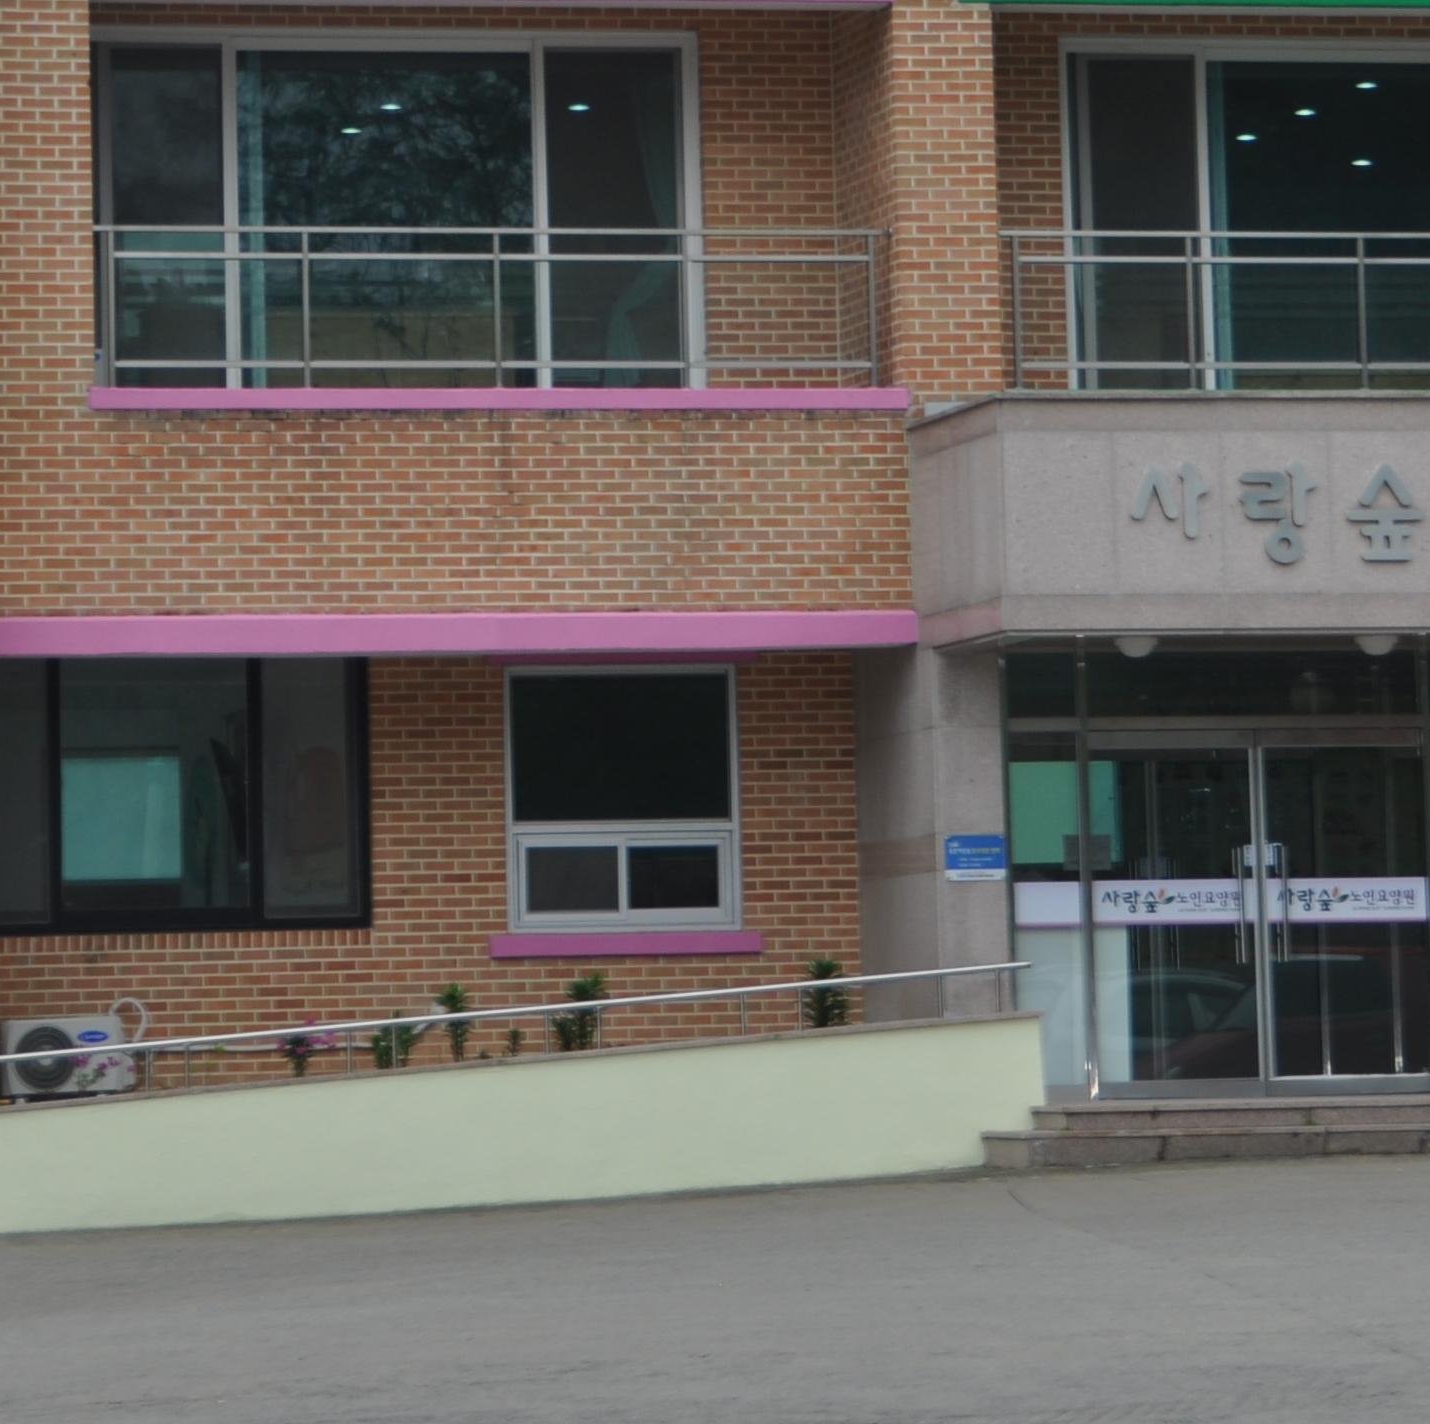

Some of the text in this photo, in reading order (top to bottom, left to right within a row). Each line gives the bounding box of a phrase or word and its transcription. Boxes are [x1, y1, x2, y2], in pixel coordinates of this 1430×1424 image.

[1101, 888, 1242, 914] 사랑숲 노인요양원
[1277, 887, 1416, 912] 사랑숲 노인요양원
